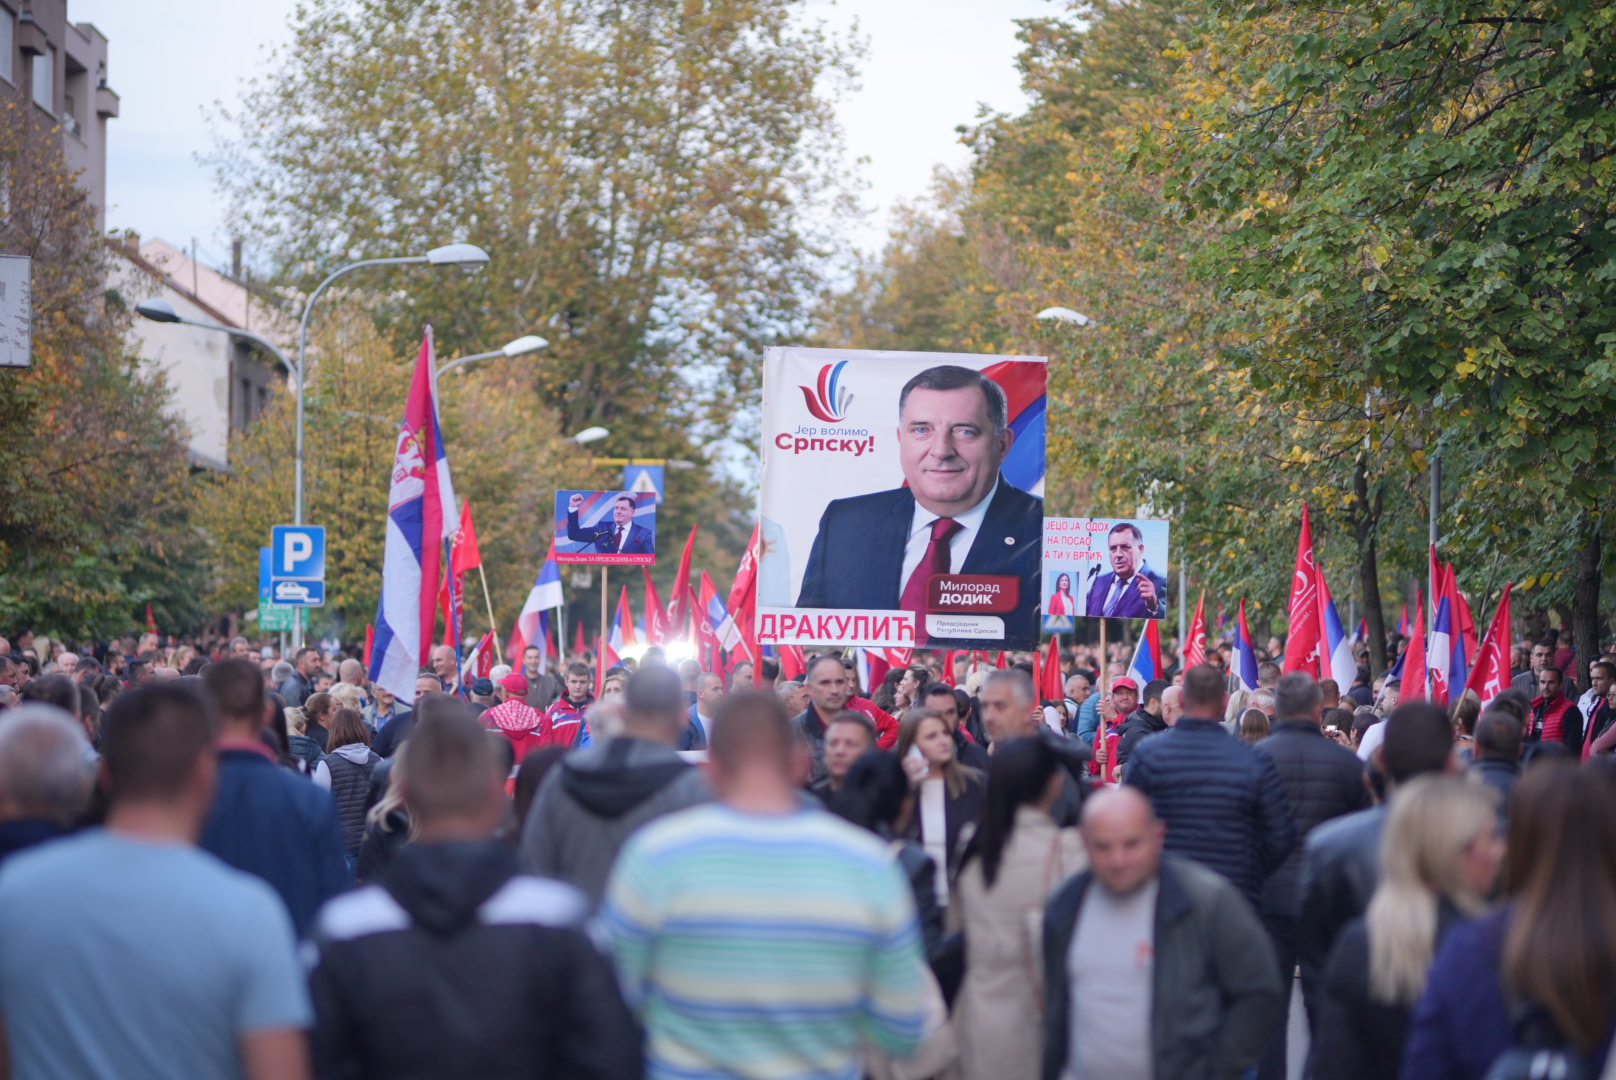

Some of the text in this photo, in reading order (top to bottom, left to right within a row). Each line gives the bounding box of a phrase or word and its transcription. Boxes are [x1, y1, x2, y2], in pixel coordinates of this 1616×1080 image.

[794, 425, 869, 437] Јер волимо
[775, 433, 875, 457] Српску!
[1045, 521, 1110, 533] ЈЕЦО ЈА ОДОХ
[1047, 536, 1092, 546] НА ПОСАО
[283, 532, 313, 572] P
[1044, 551, 1103, 561] А ТИ У ВРТИЋ
[940, 580, 1001, 594] Милорад
[938, 593, 993, 606] ДОДИК
[757, 614, 915, 643] ДРАКУЛИЋ
[973, 627, 998, 635] Српске
